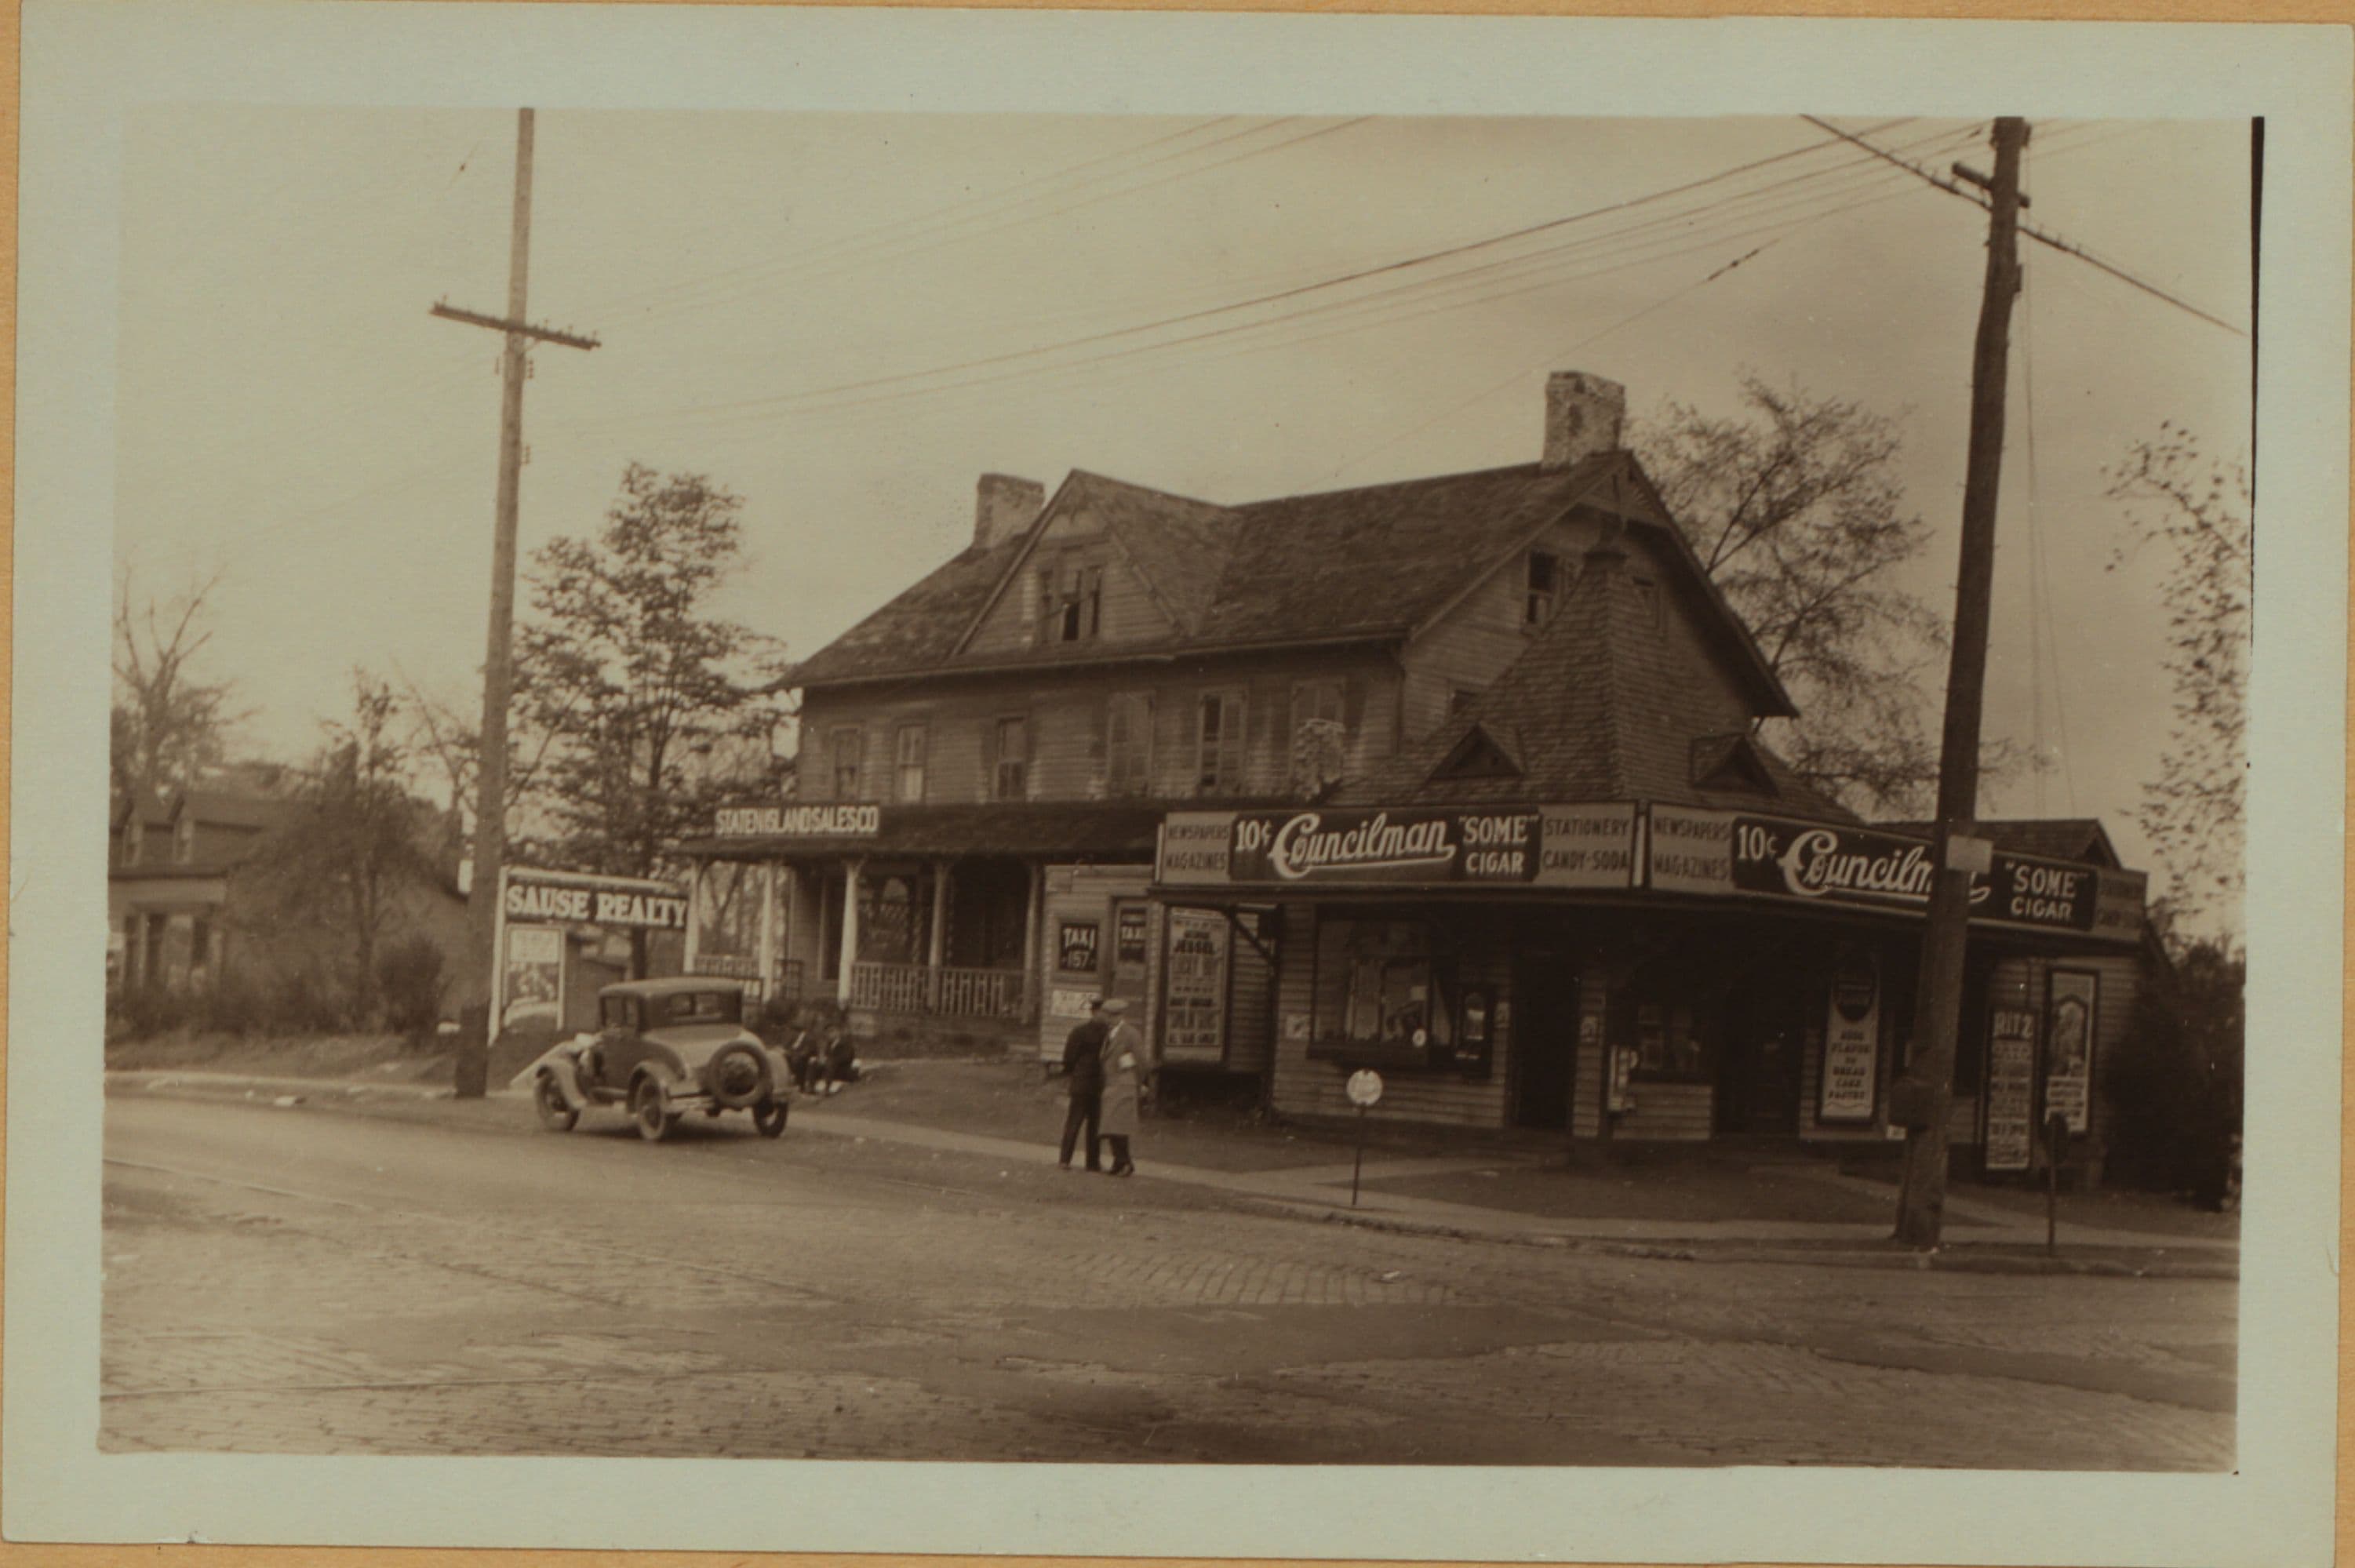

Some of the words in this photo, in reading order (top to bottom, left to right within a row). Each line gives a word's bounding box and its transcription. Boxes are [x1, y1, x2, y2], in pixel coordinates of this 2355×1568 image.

[812, 805, 857, 832] SALES
[1544, 817, 1631, 837] STATIONERY
[1266, 811, 1457, 879] Councilman
[1464, 850, 1526, 877] CIGAR
[506, 884, 591, 921] SAUSE
[595, 891, 689, 927] REALTY
[2010, 896, 2073, 922] CIGAR
[1063, 927, 1096, 950] TAXI
